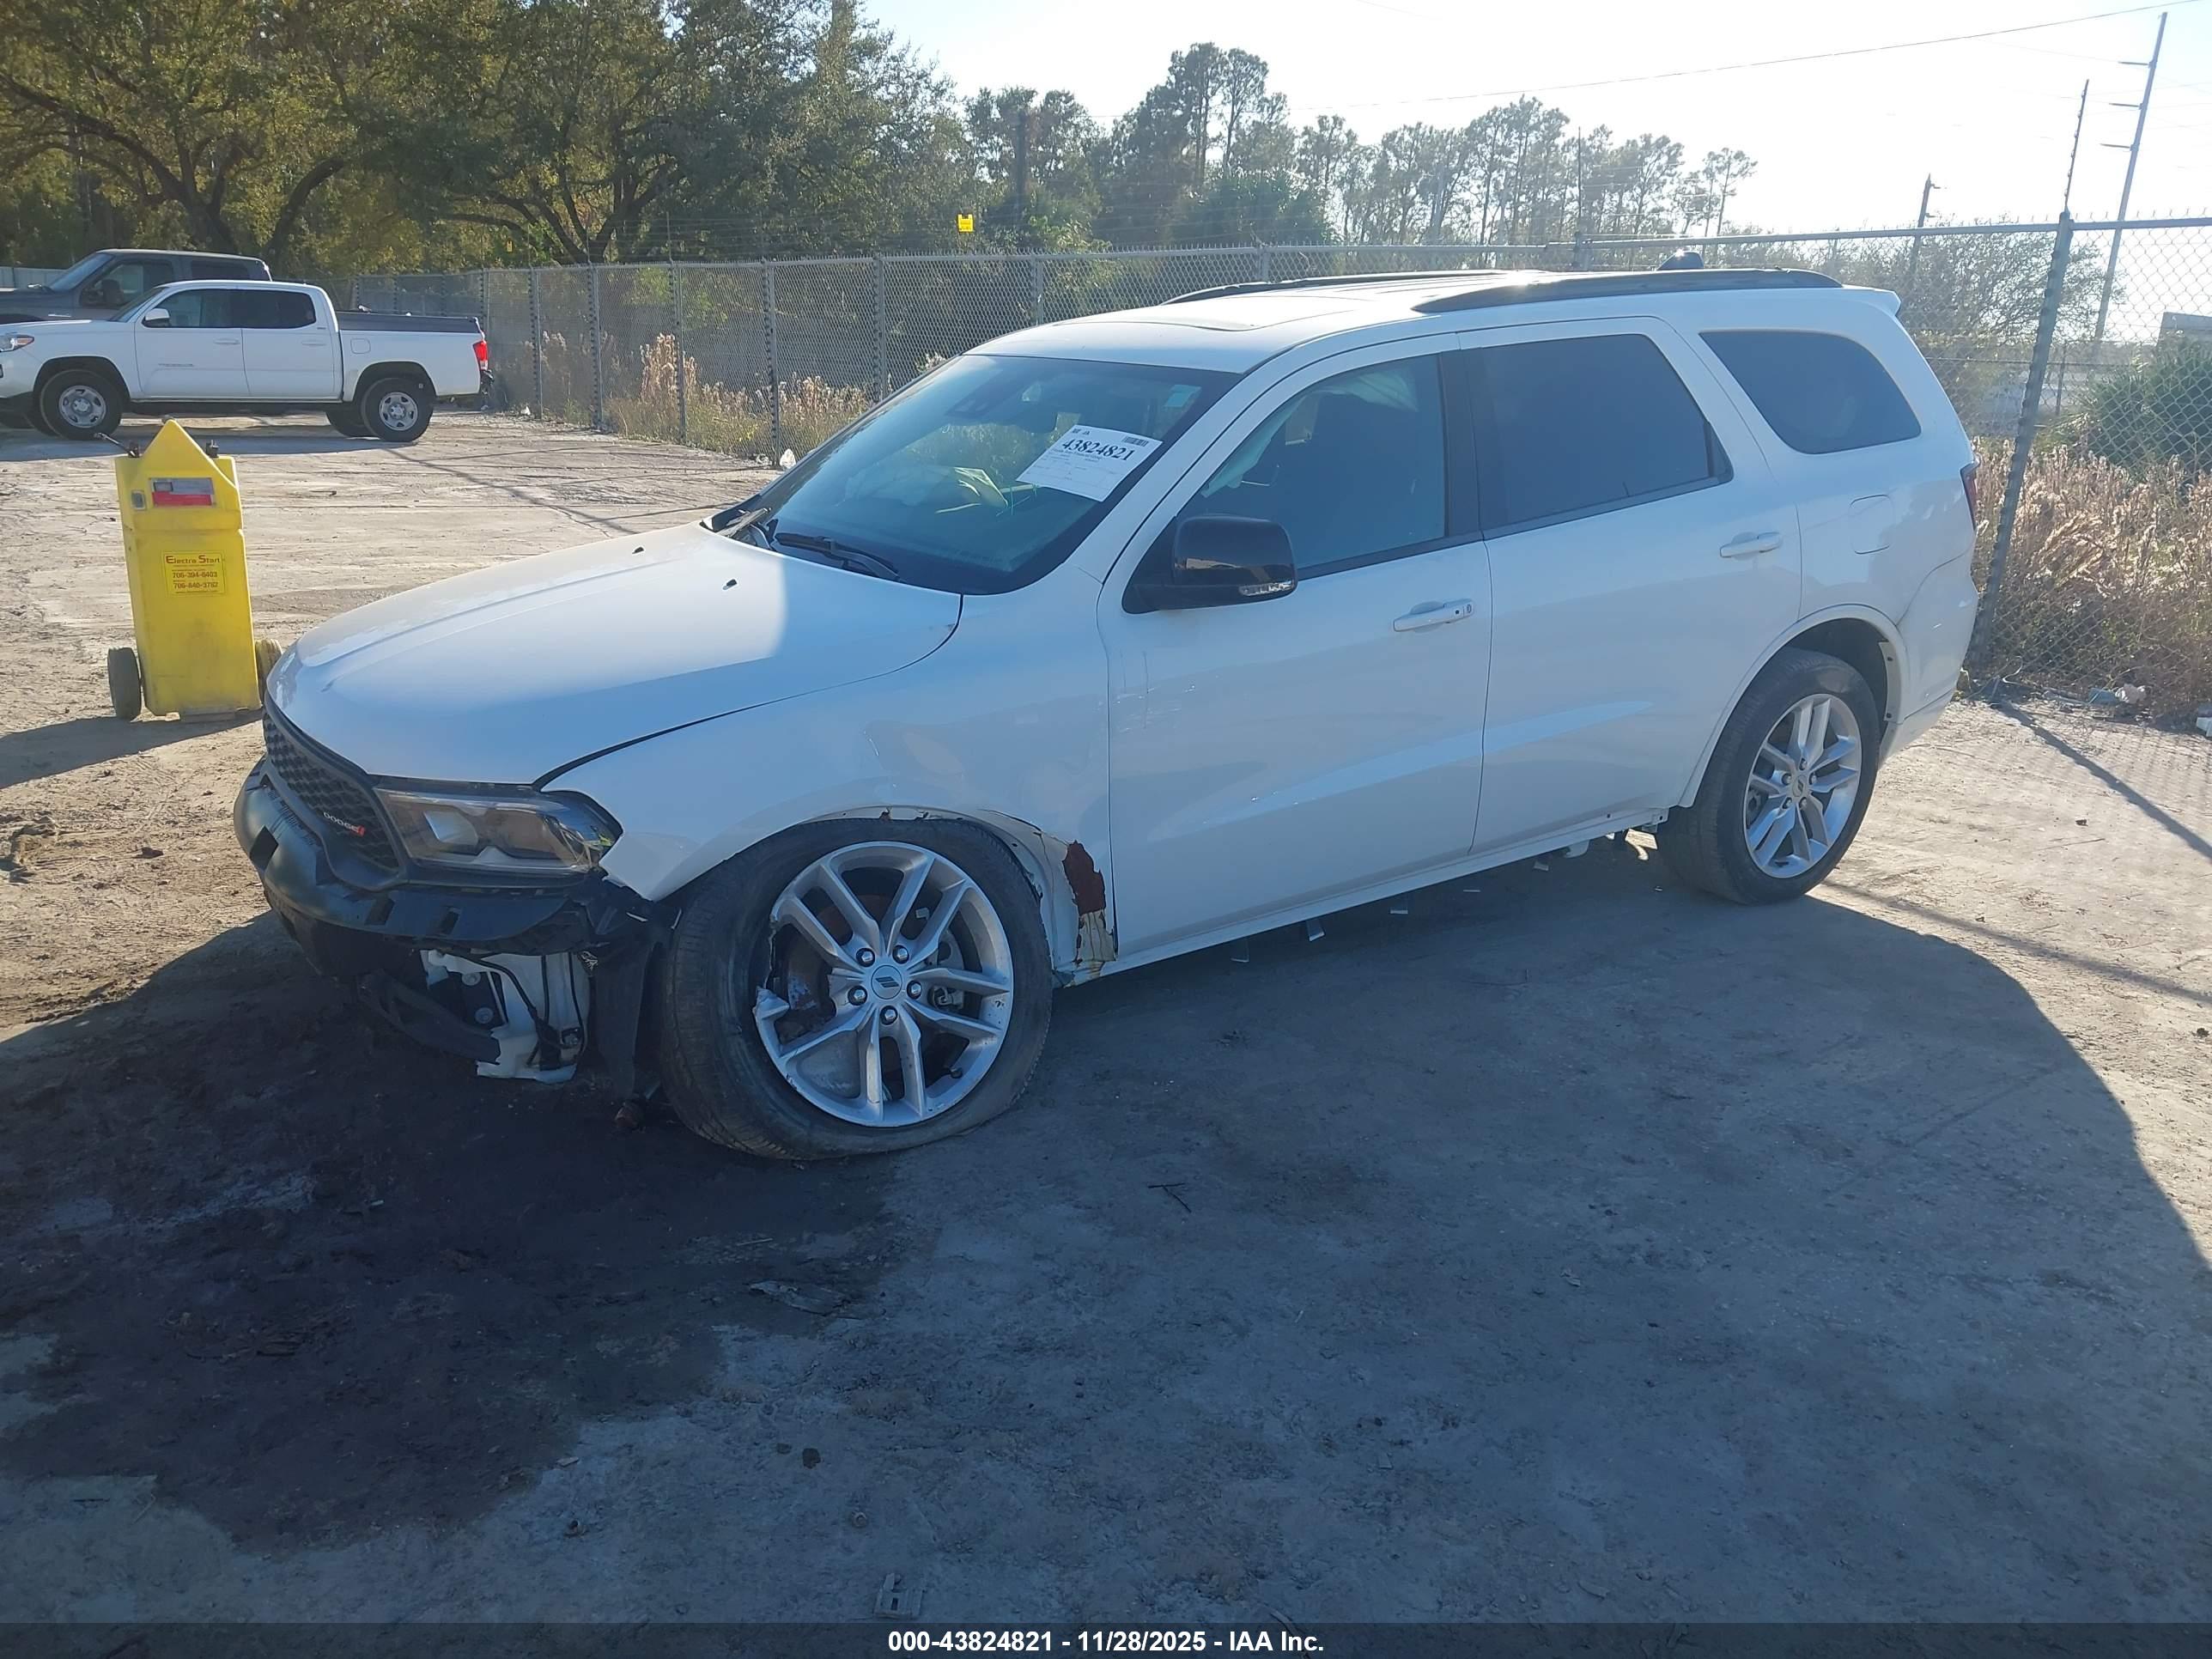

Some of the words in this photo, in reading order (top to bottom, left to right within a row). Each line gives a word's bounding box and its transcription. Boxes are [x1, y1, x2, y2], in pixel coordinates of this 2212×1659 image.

[1063, 439, 1135, 460] 43824821
[198, 555, 220, 563] Start
[323, 811, 359, 833] DODGE
